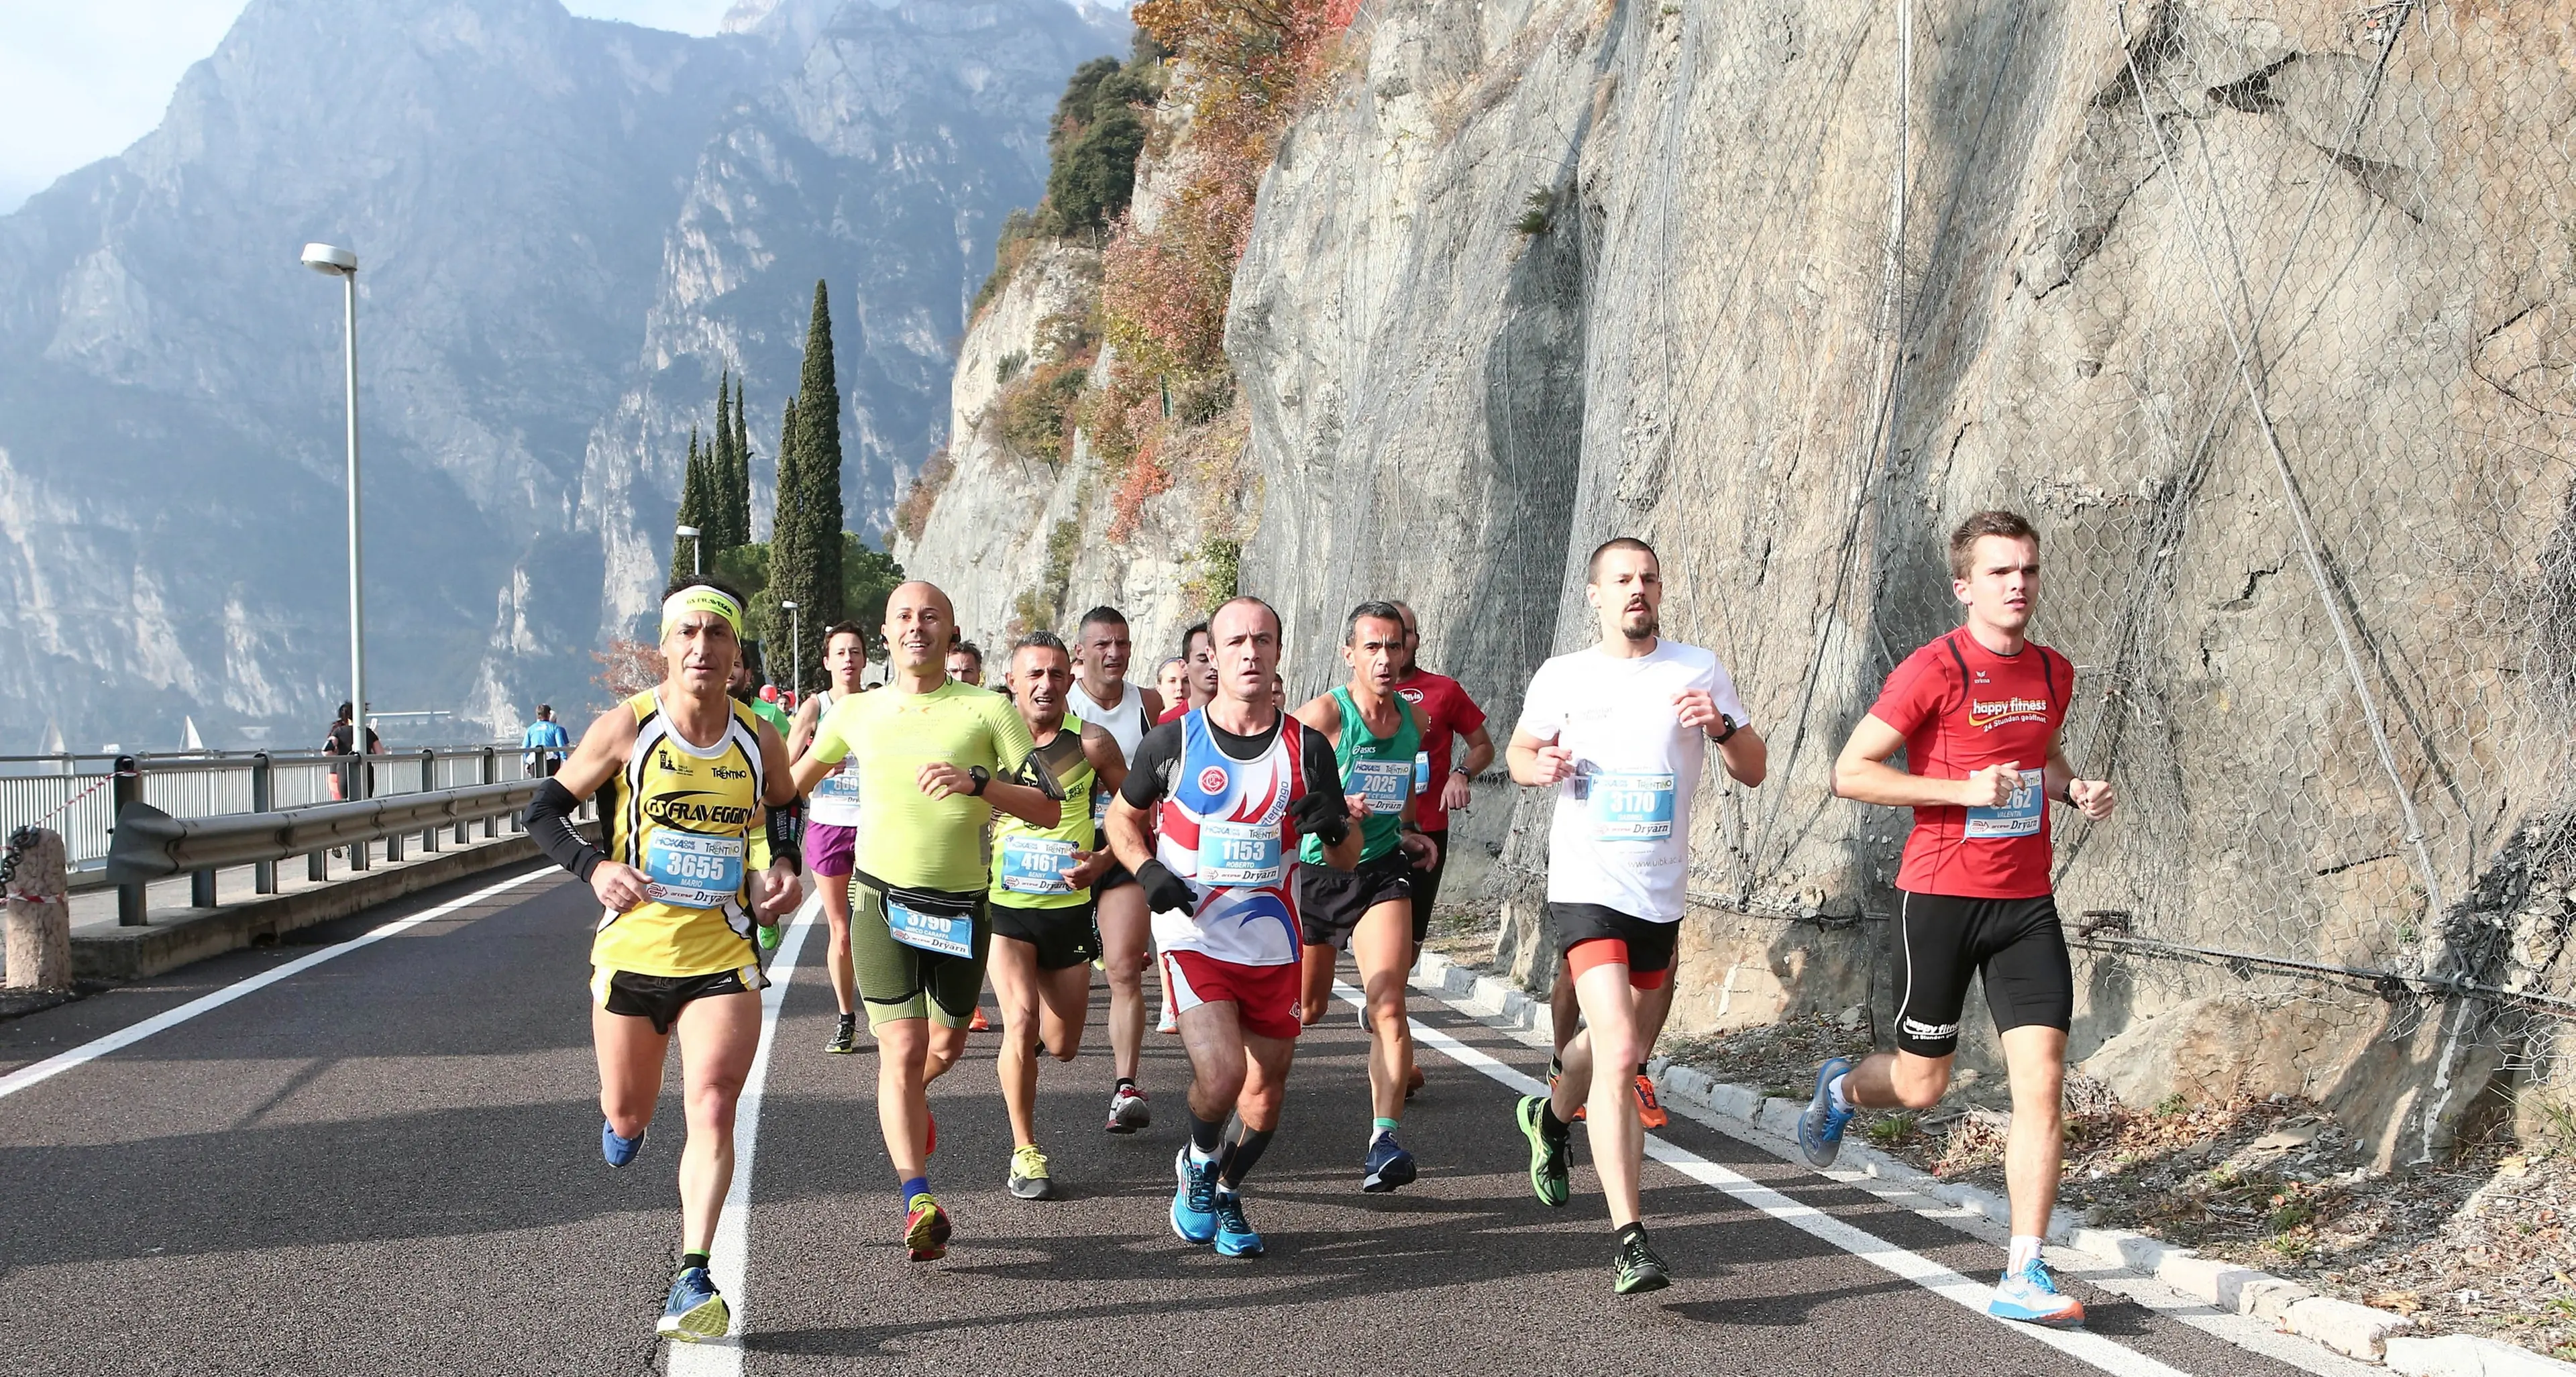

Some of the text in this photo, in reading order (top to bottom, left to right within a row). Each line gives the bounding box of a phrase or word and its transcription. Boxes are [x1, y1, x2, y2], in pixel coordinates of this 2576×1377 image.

[1973, 696, 2047, 715] happy fitness
[1983, 723, 1992, 732] 24
[1993, 715, 2020, 727] Stunden
[711, 766, 747, 779] TRENTINO
[1385, 765, 1409, 774] TRENTINO
[1362, 775, 1397, 793] 2025
[1636, 779, 1672, 789] TRENTINO
[1375, 801, 1402, 811] Dryarn
[1609, 791, 1656, 813] 3170
[647, 800, 749, 824] GS FRAVEGGIO
[1997, 810, 2023, 818] VALENTIN
[1633, 824, 1668, 835] Dryarn
[2010, 820, 2037, 831] Dryarn
[1249, 828, 1279, 839] TRENTINO
[705, 842, 739, 855] TRENTINO
[1222, 840, 1266, 861] 1153
[666, 852, 724, 881] 3655
[1020, 852, 1058, 872] 4161
[1242, 871, 1277, 881] Dryarn
[681, 879, 703, 887] MARIO
[694, 891, 733, 905] Dryarn
[906, 912, 951, 932] 3790
[931, 939, 966, 952] Dryarn
[1907, 1015, 1938, 1034] happy
